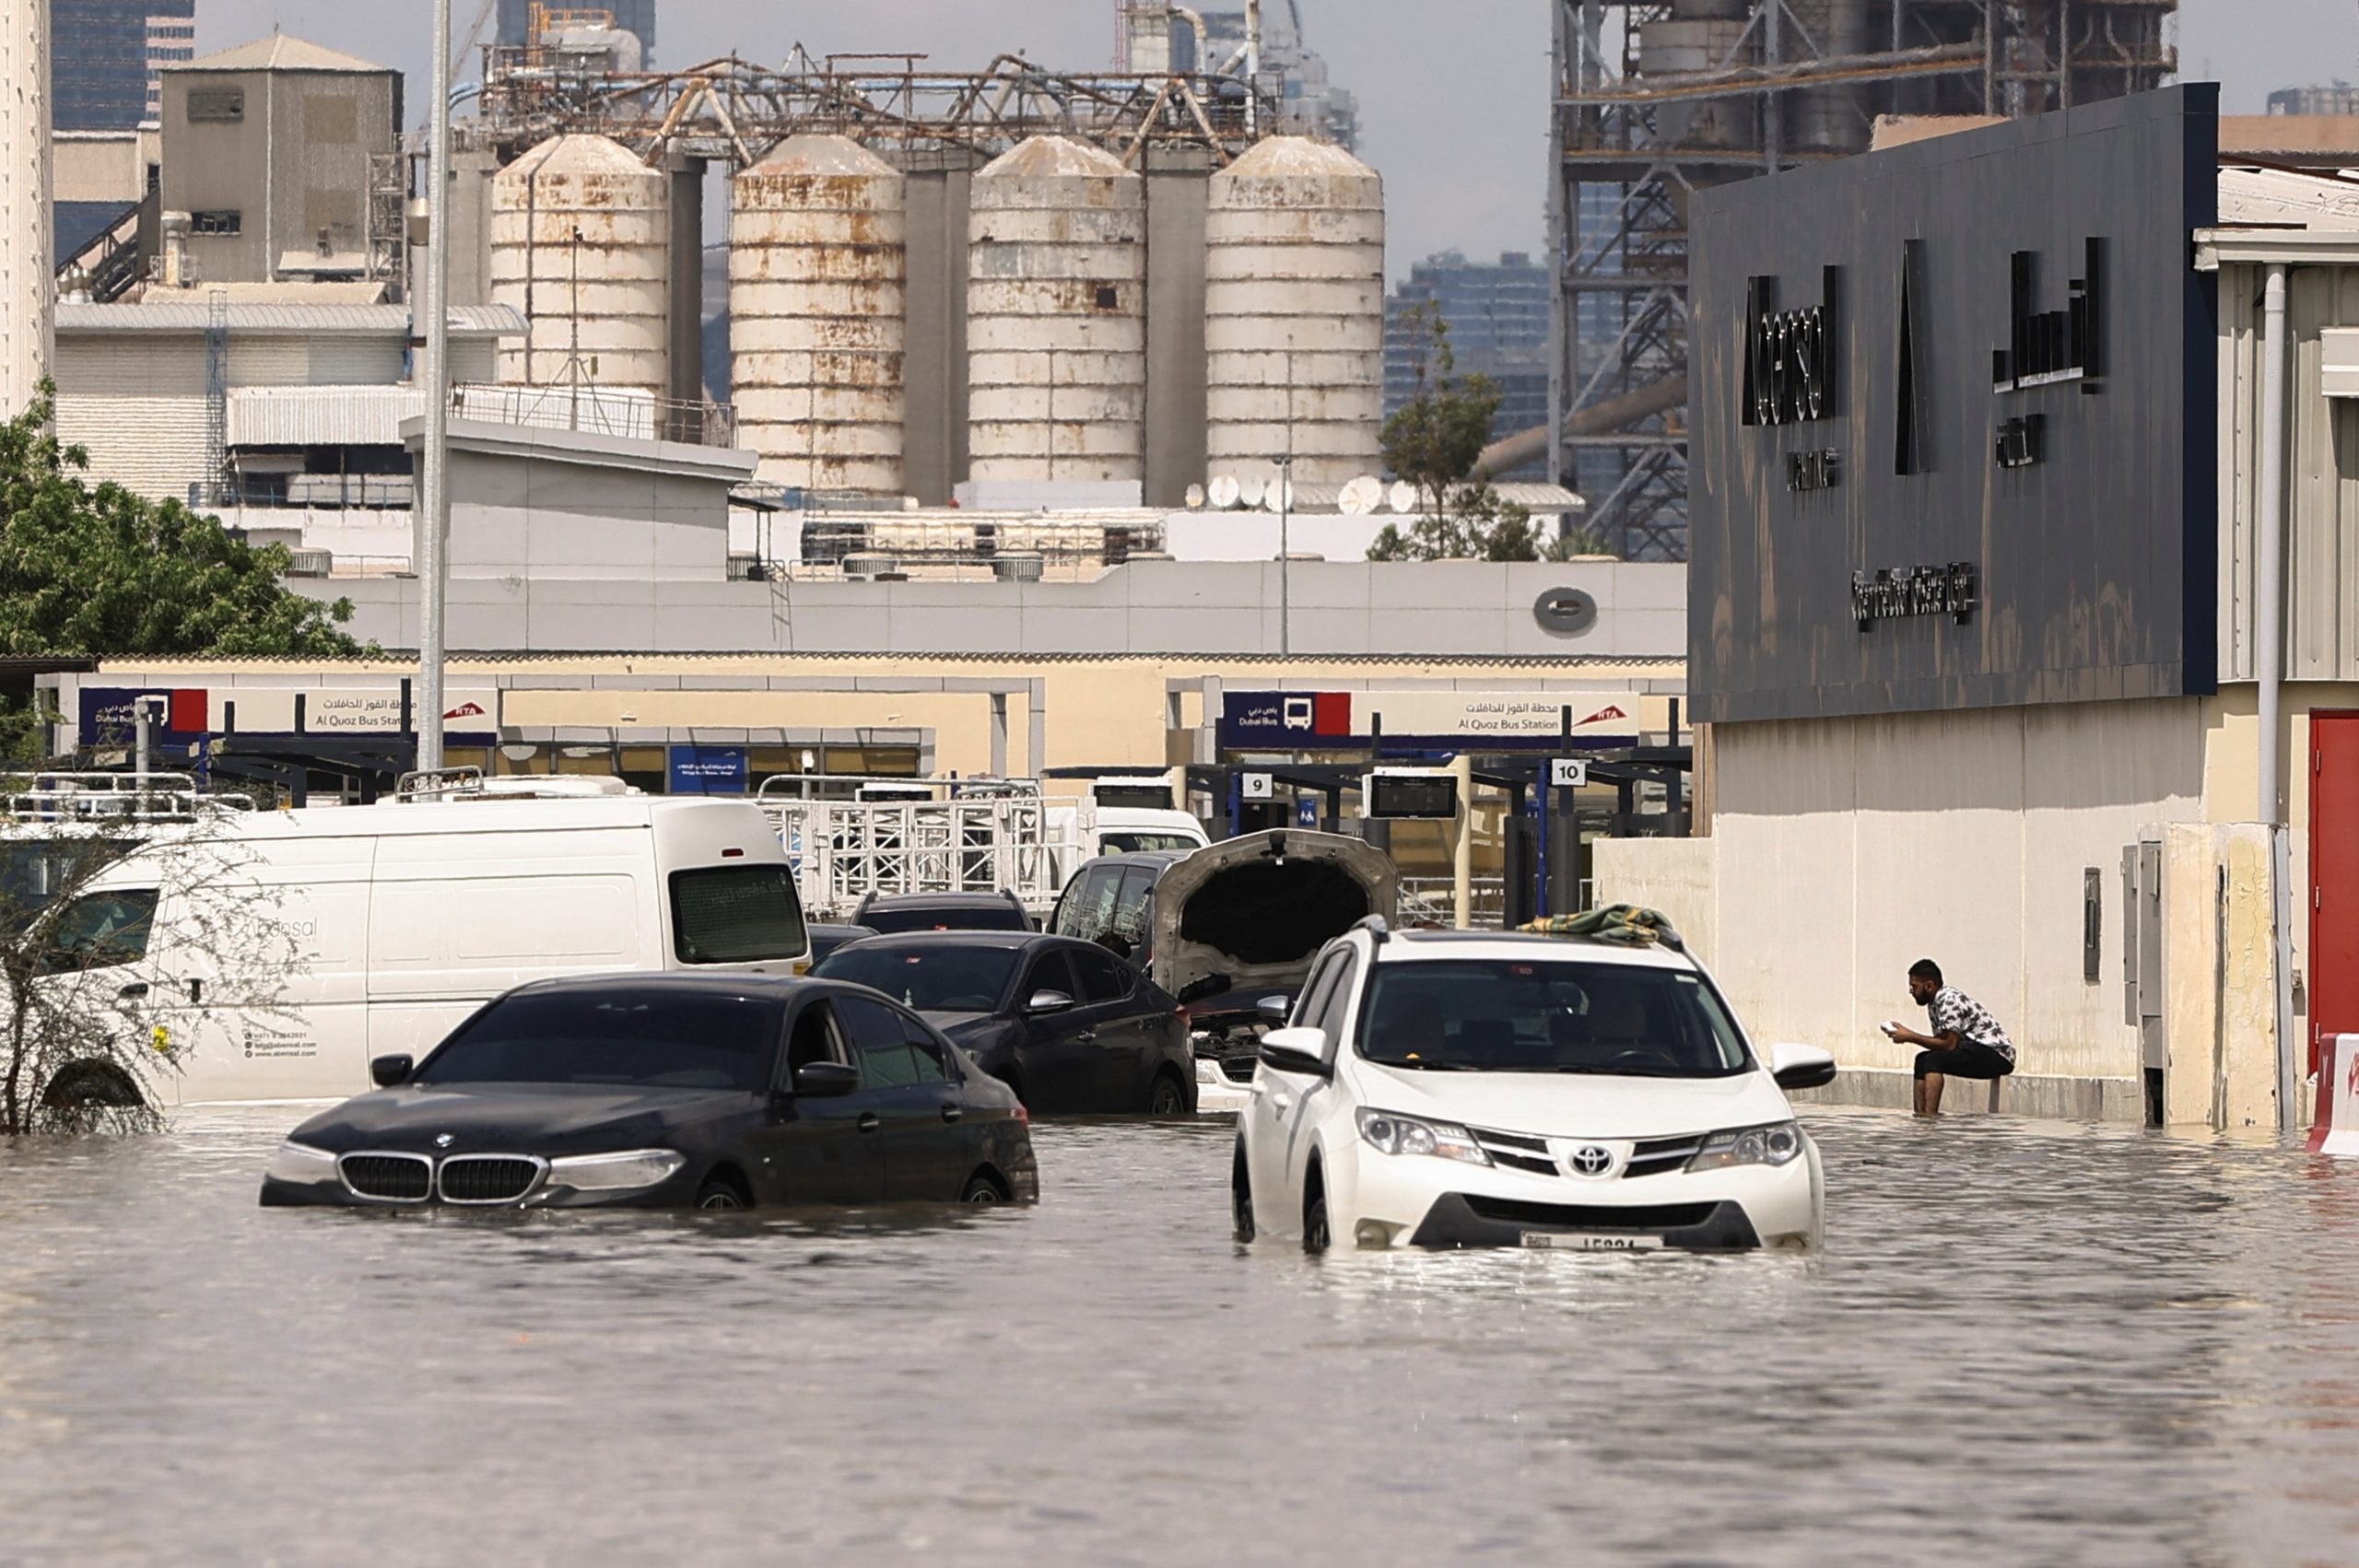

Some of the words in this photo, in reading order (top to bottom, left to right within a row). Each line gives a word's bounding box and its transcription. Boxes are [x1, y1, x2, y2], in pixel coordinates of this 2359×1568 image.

[323, 698, 363, 709] للحافلات
[364, 698, 388, 710] القوز
[1466, 703, 1505, 713] للحافلات
[1506, 703, 1530, 715] القوز
[1531, 703, 1558, 713] محطة
[316, 715, 327, 726] Al
[329, 716, 357, 728] Quoz
[358, 716, 380, 726] Bus
[1238, 717, 1262, 727] Dubai
[1262, 717, 1279, 727] Bus
[1459, 719, 1471, 730] Al
[1472, 719, 1498, 730] Quoz
[1500, 719, 1520, 730] Bus
[1520, 719, 1558, 730] Station
[1558, 766, 1579, 779] 10
[1252, 779, 1262, 791] 9
